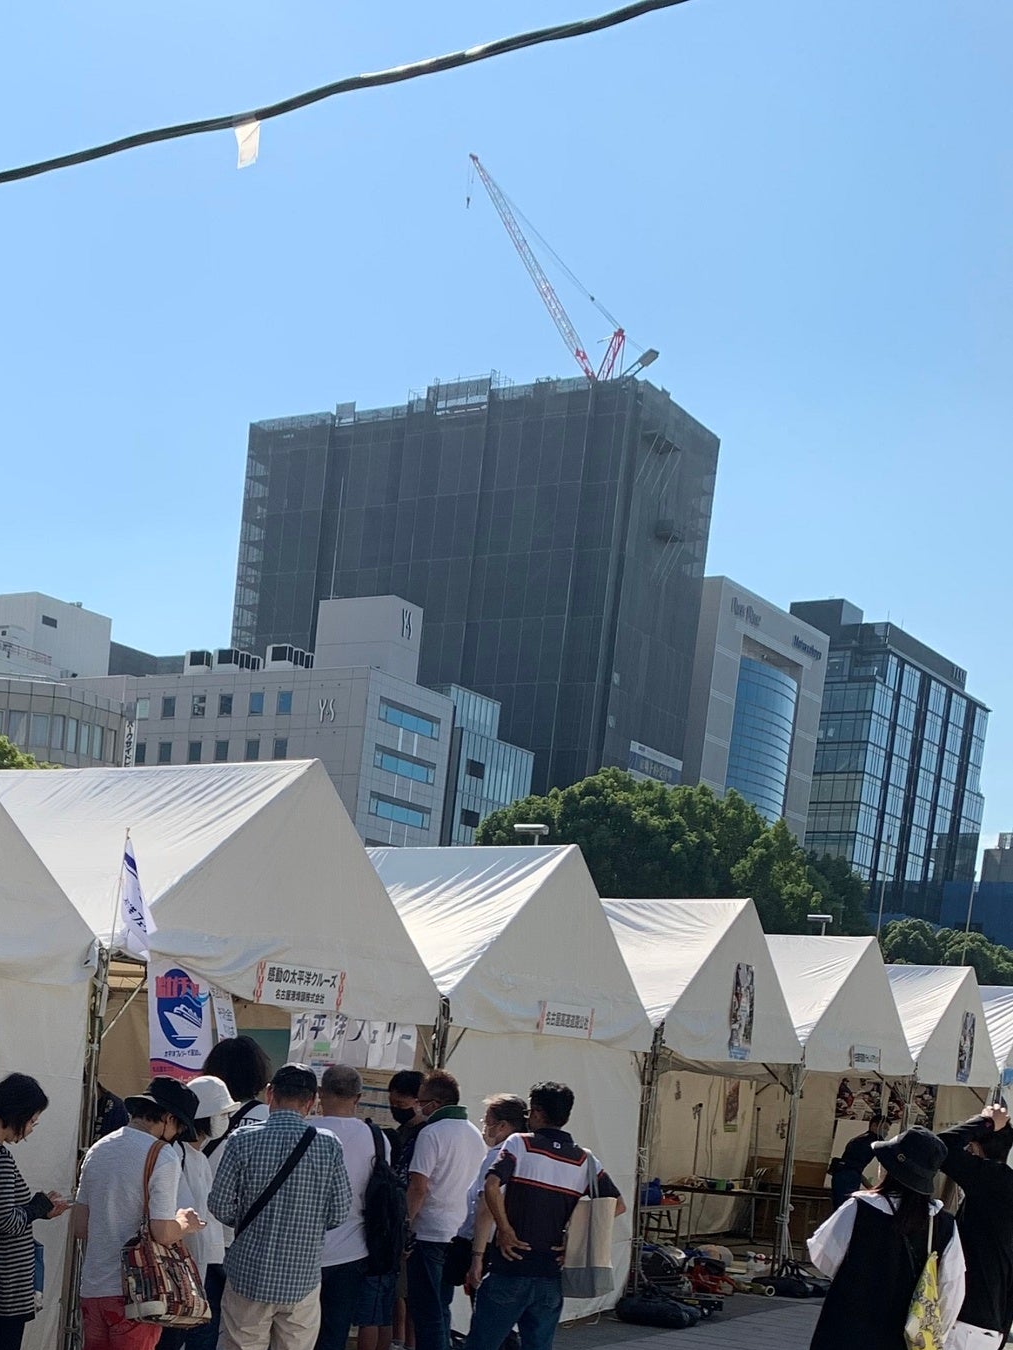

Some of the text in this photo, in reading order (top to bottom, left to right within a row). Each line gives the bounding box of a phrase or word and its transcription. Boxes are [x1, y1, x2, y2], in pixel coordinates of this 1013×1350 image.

[267, 966, 338, 988] 感動の太平洋クルーズ
[292, 1014, 412, 1046] 太平洋フェリー
